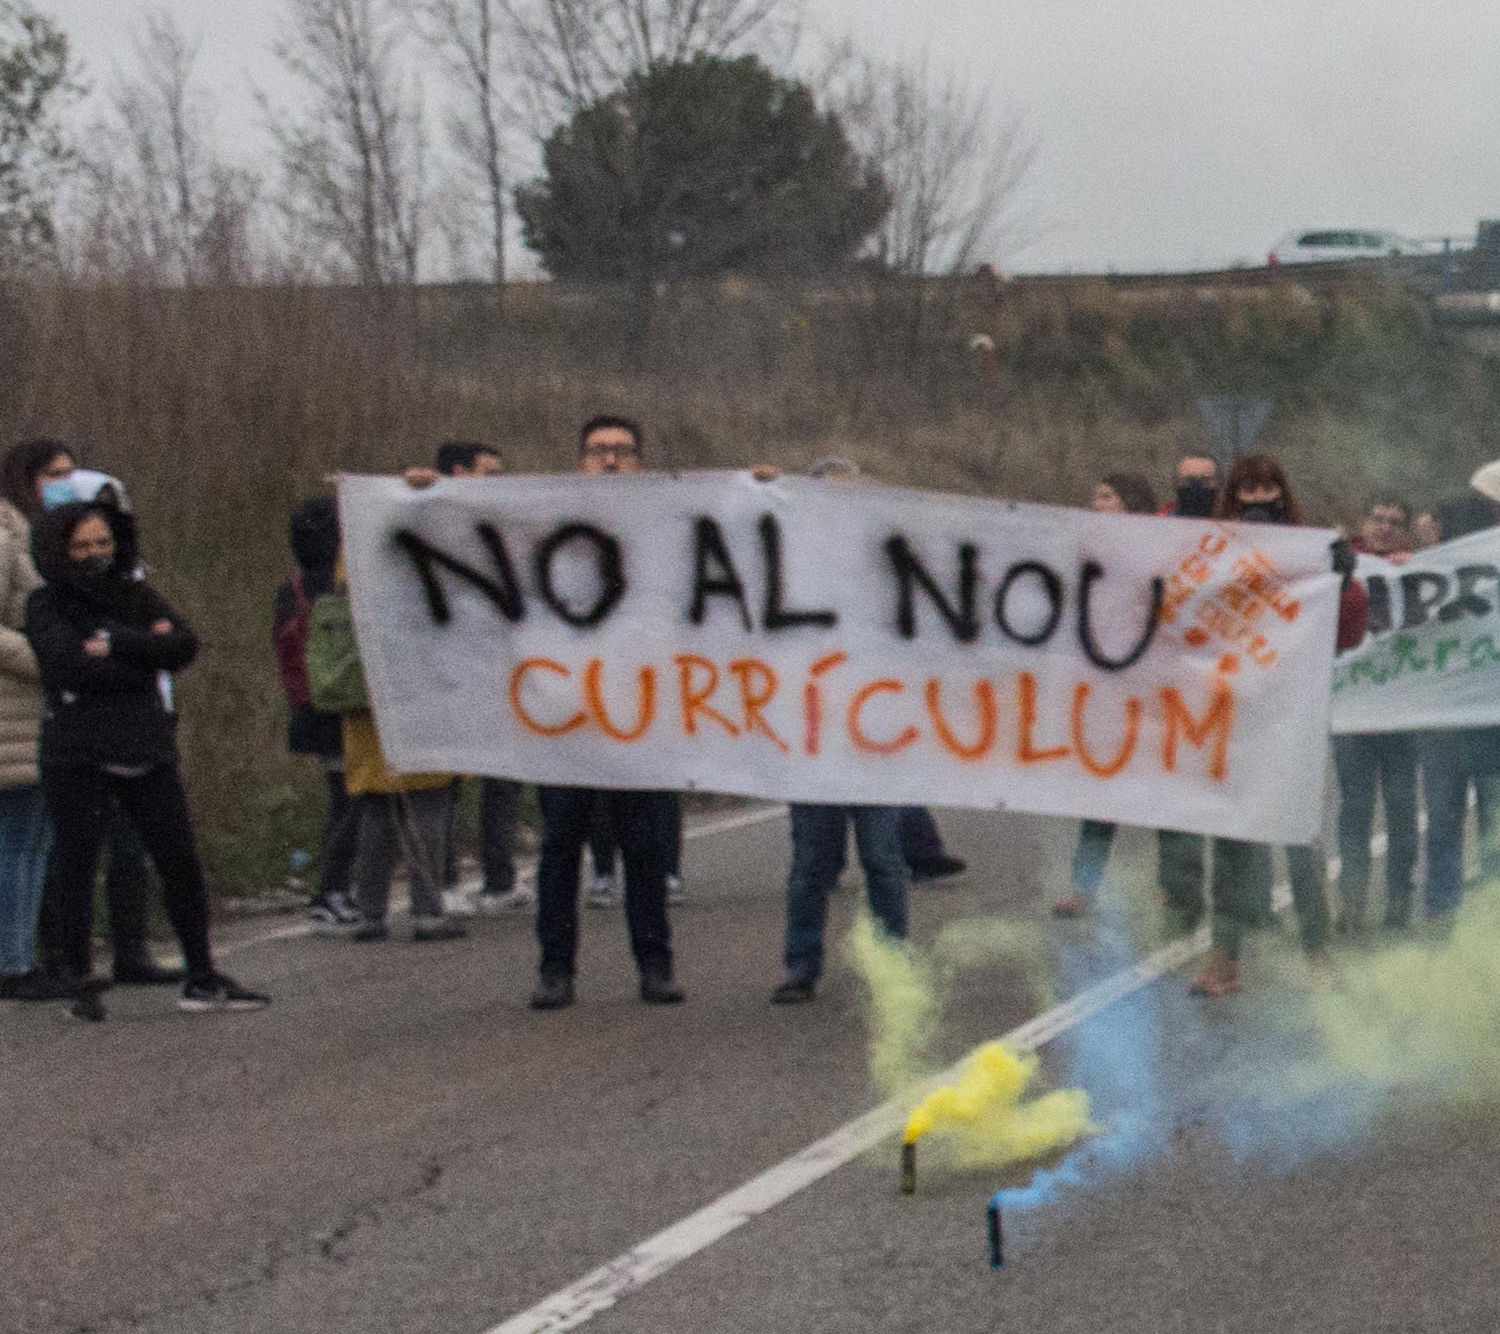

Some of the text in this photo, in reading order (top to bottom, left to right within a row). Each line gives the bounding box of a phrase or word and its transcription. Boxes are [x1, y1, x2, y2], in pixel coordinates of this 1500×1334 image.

[390, 517, 627, 629] NO
[688, 512, 838, 633] AL
[884, 535, 1165, 672] NOU
[509, 650, 1238, 783] CURRÍCULUM
